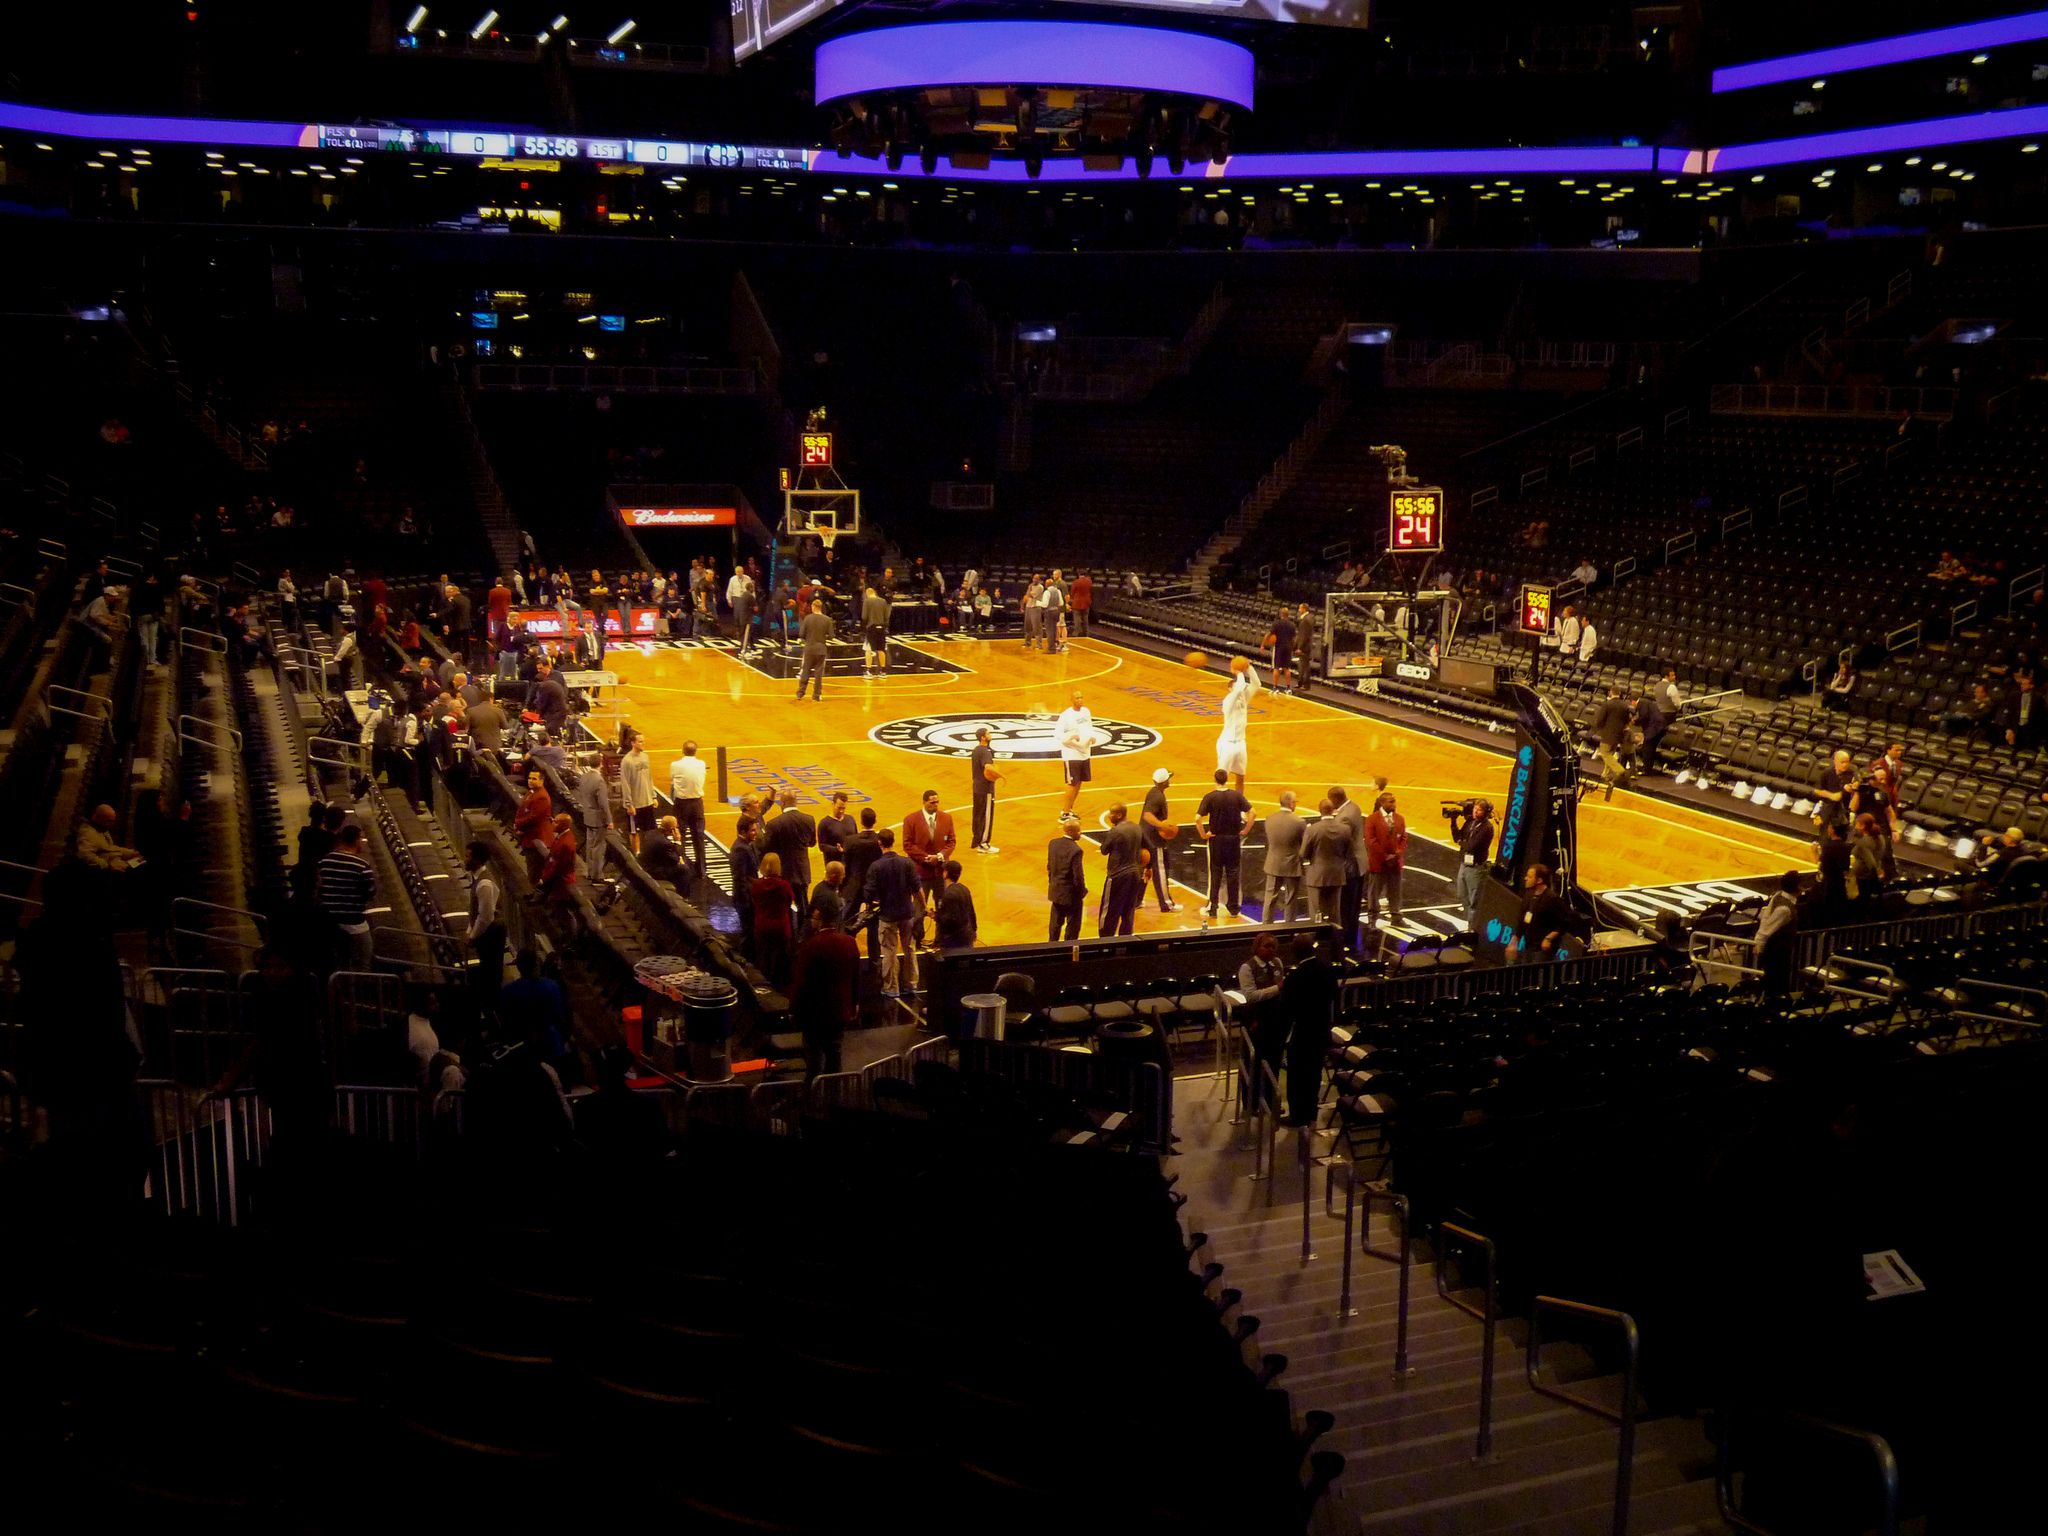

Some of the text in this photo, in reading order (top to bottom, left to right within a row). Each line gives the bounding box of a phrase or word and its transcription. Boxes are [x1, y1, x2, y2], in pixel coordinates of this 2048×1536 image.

[473, 136, 485, 153] 0
[524, 137, 579, 157] 55:56
[593, 145, 618, 158] 1ST
[657, 146, 668, 161] 0
[806, 446, 827, 463] 24
[1395, 497, 1436, 516] 55:56
[632, 509, 716, 525] Budweiser
[1399, 516, 1431, 544] 24
[1529, 607, 1546, 626] 24
[529, 620, 561, 633] NBA
[1502, 767, 1529, 860] BARCLAYS
